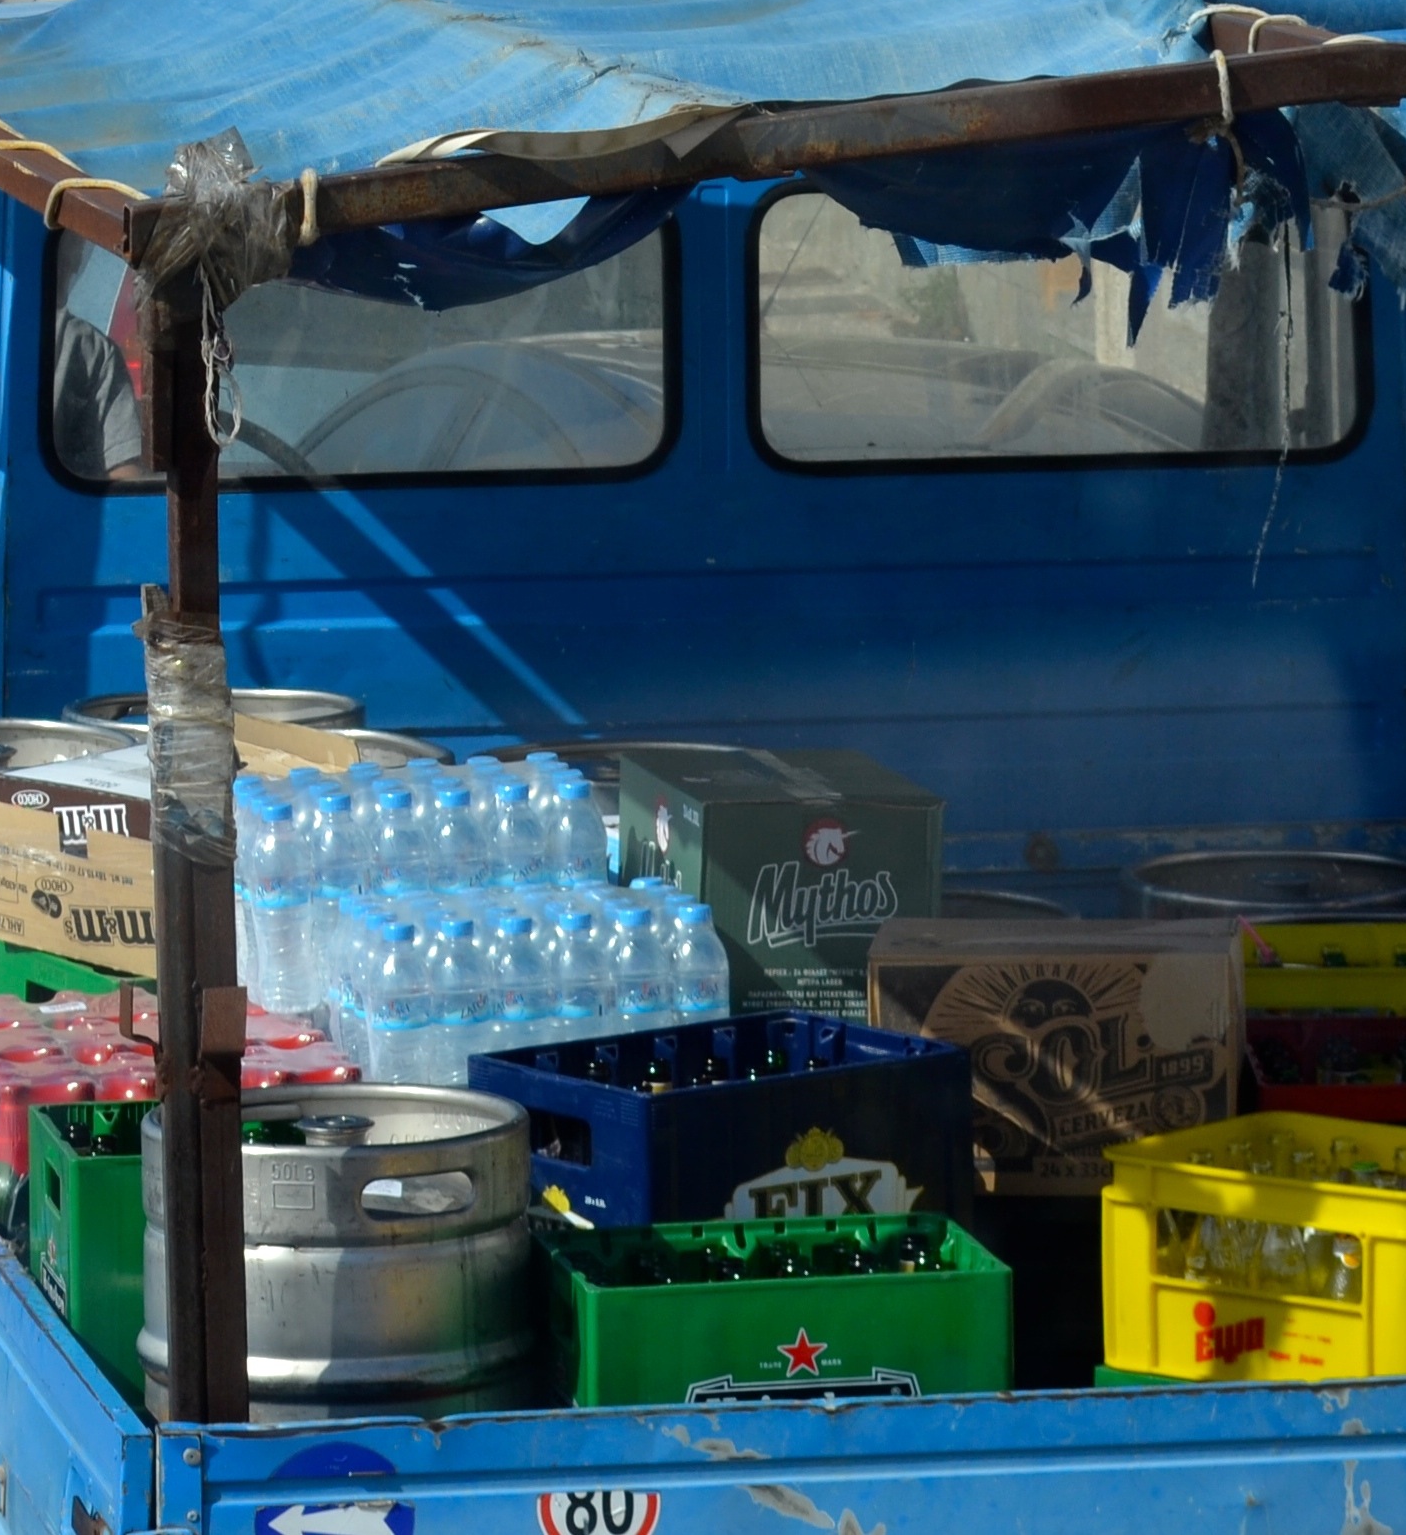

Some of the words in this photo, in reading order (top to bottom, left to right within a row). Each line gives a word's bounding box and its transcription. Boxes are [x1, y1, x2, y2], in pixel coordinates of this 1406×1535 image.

[747, 861, 899, 949] Mythos
[1059, 1101, 1150, 1137] CERVEZA
[565, 1490, 635, 1535] 80
